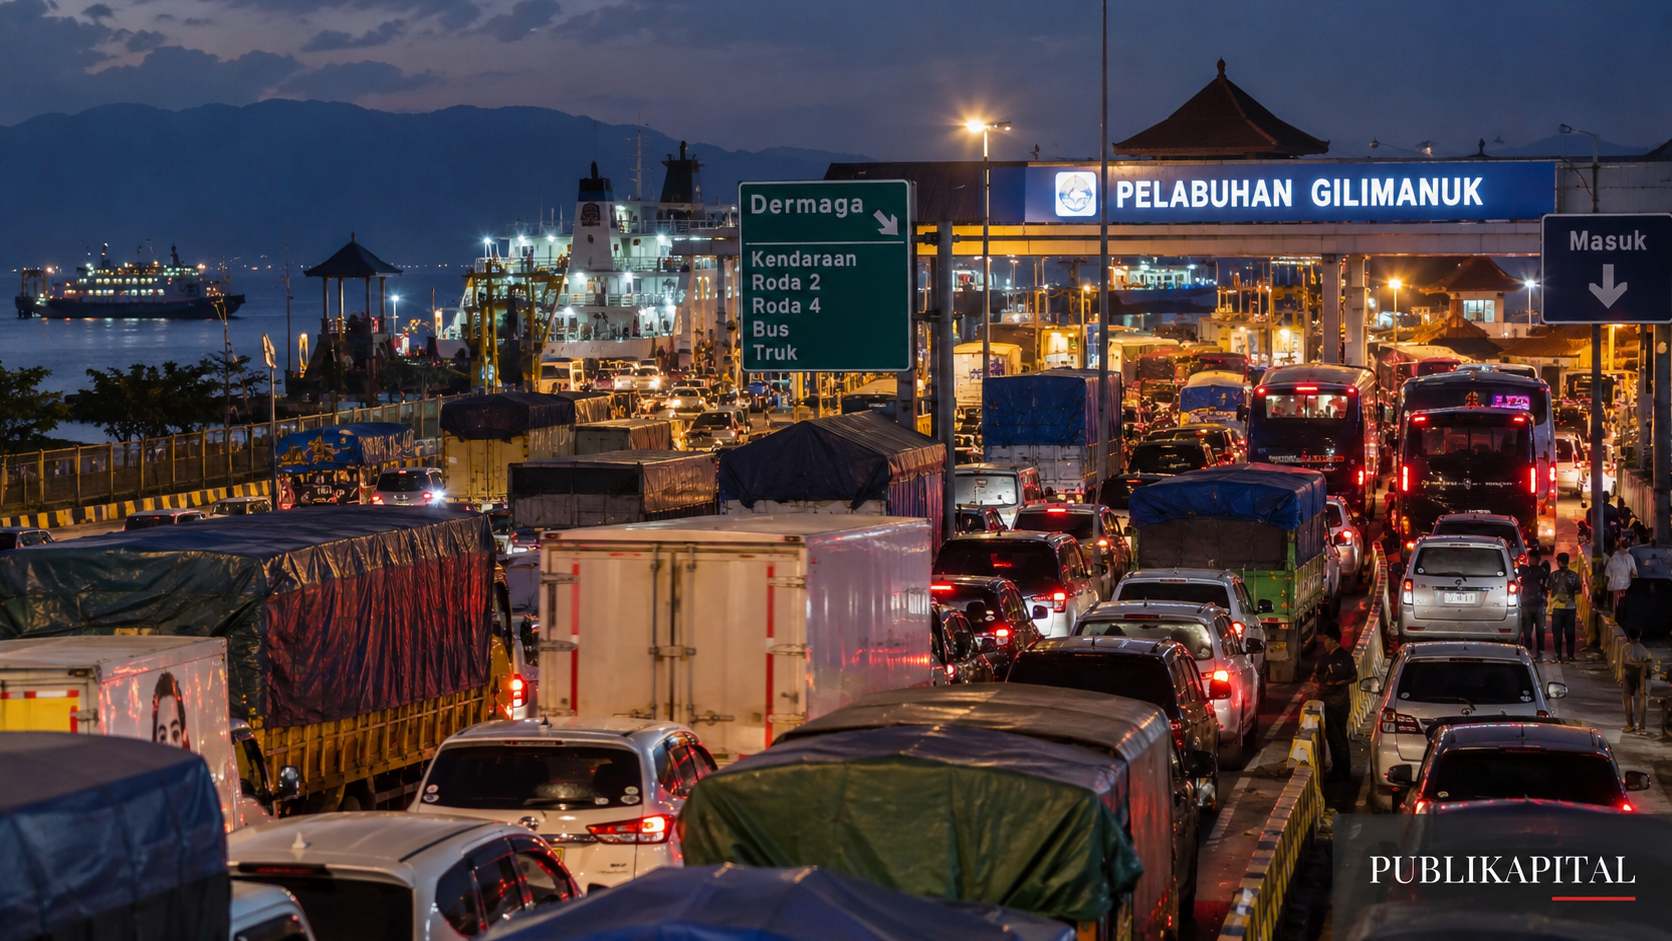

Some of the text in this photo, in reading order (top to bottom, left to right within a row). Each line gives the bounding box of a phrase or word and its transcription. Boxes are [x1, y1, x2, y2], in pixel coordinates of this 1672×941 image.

[1116, 177, 1483, 208] PELABUHAN GILIMANUK
[752, 194, 863, 219] Dermaga
[1570, 230, 1647, 251] Masuk
[752, 250, 857, 268] Kendaraan
[752, 273, 821, 291] Roda 2
[752, 297, 821, 314] Roda 4
[753, 320, 789, 338] Bus
[753, 344, 798, 361] Truk
